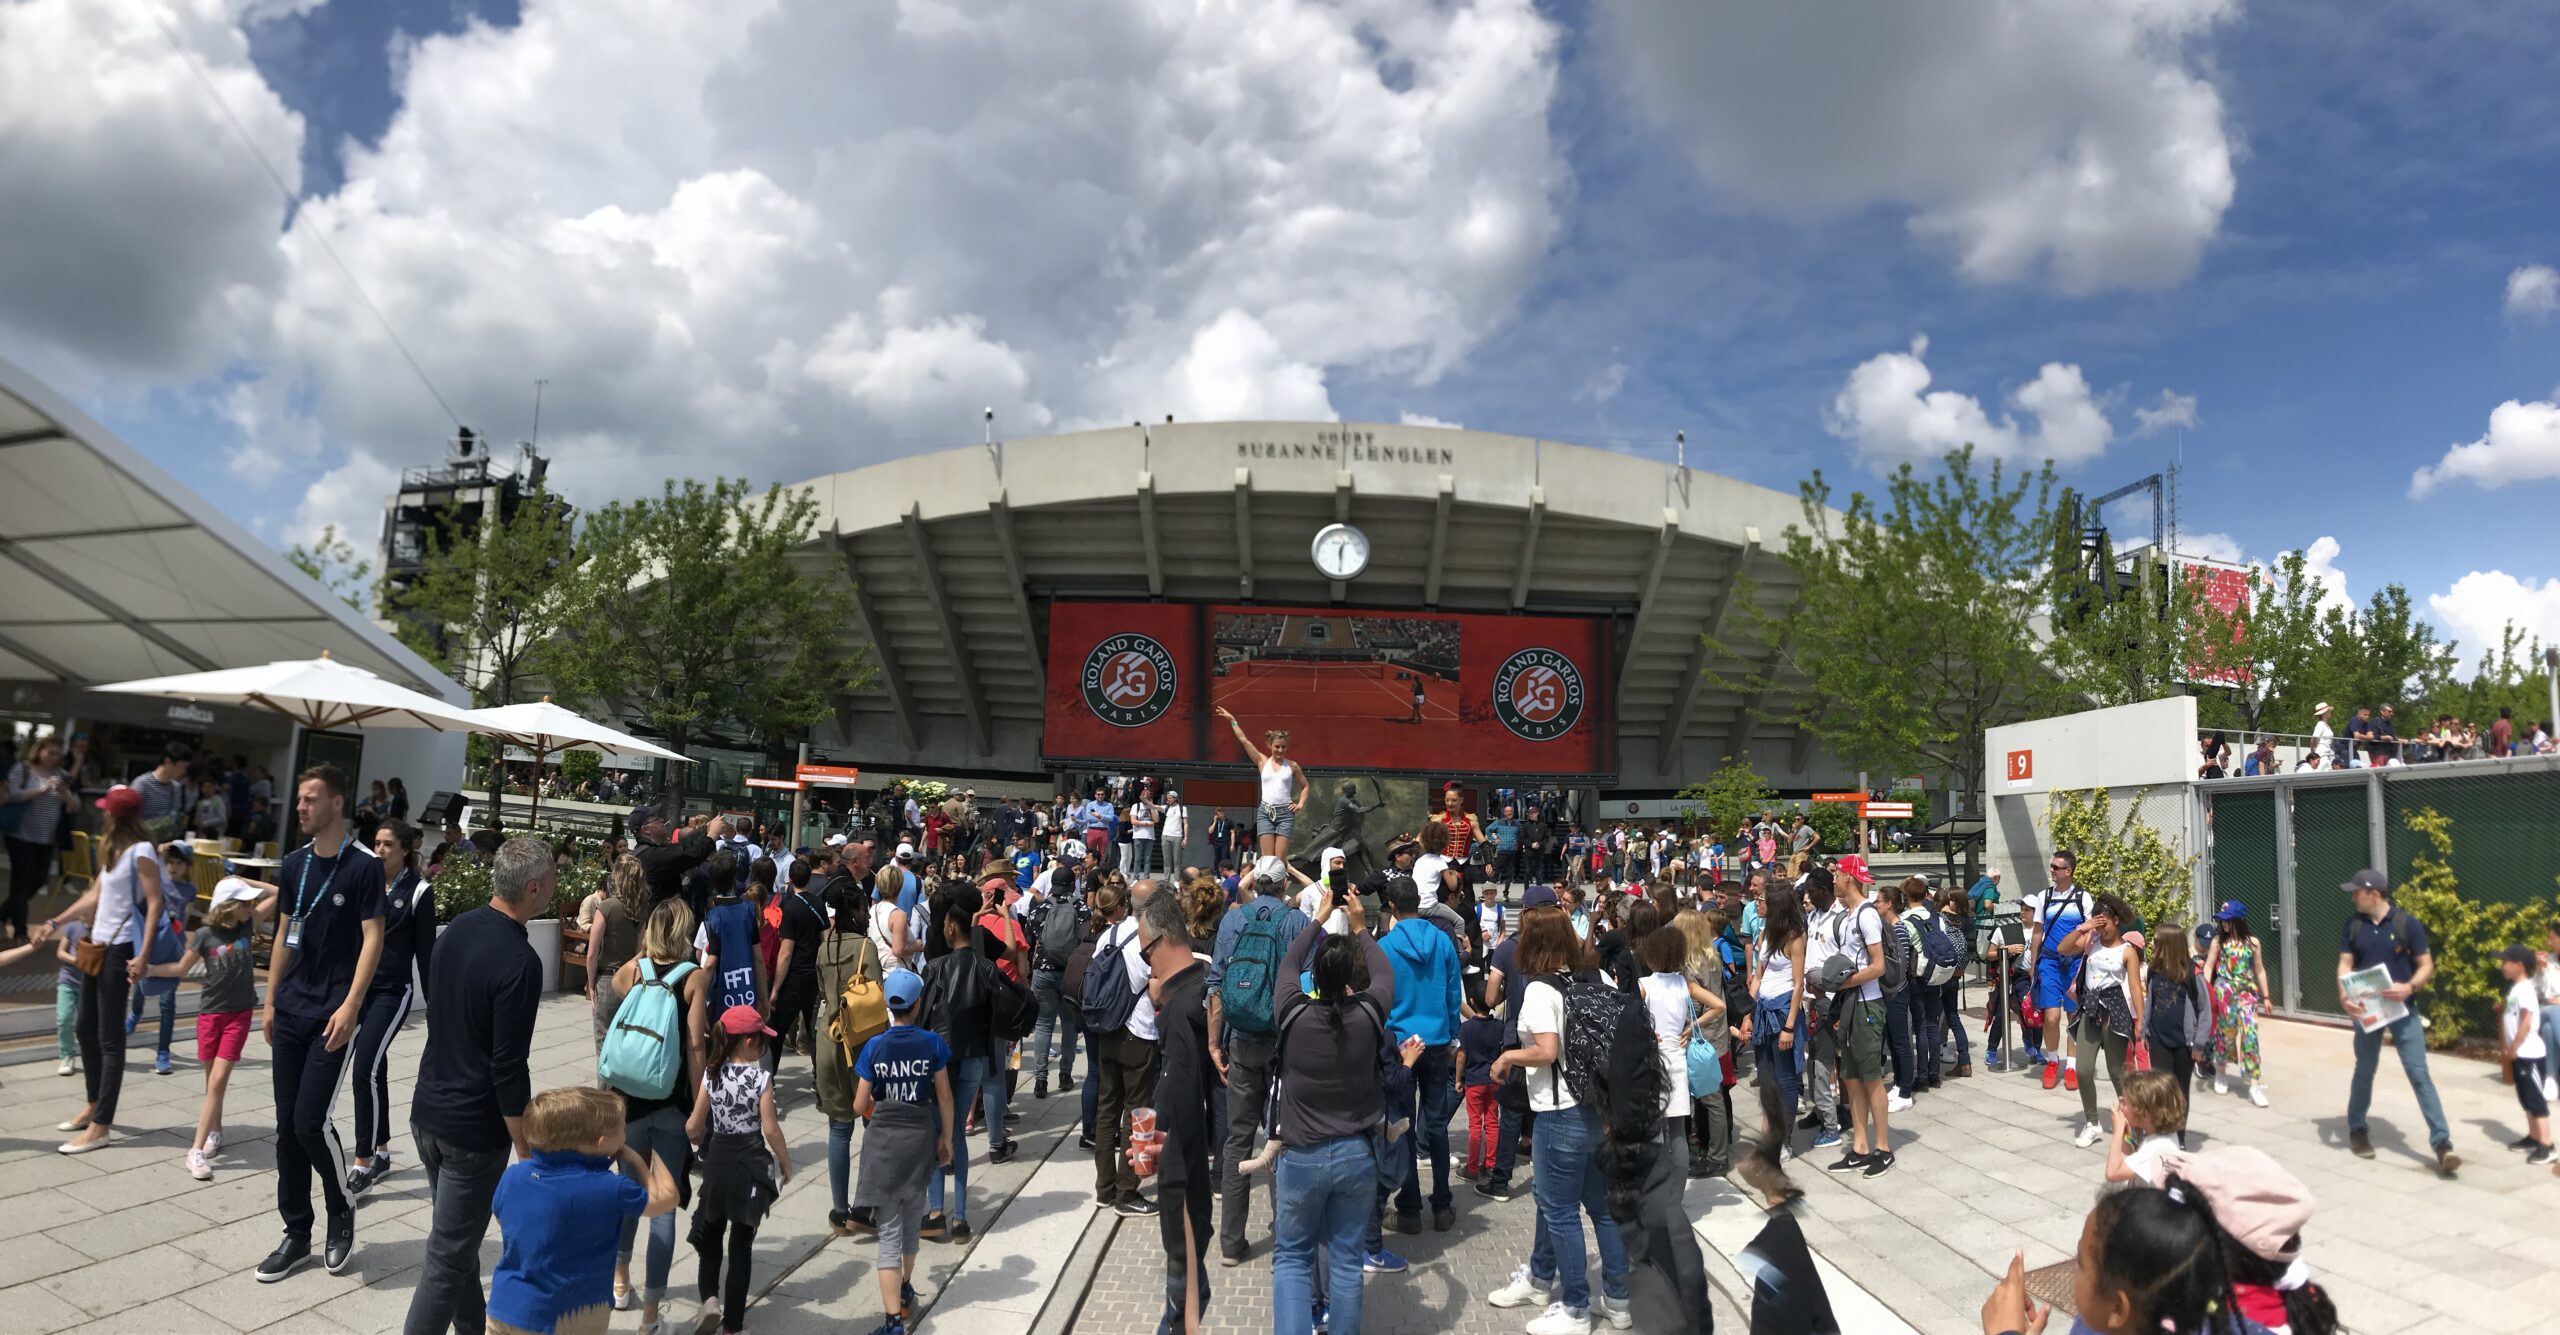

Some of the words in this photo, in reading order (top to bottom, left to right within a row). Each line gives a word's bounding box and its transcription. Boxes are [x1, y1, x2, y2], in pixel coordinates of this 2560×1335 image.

[1317, 432, 1375, 446] COURT
[1237, 442, 1338, 461] SUZANNE
[1353, 446, 1454, 465] LENGLEN
[1086, 638, 1128, 689] ROLAND
[1133, 639, 1173, 691] GARROS
[1497, 652, 1538, 703] ROLAND
[1541, 653, 1580, 705] GARROS
[1099, 702, 1158, 721] PARIS
[1510, 716, 1567, 735] PARIS
[2017, 754, 2027, 776] 9
[723, 967, 752, 990] FFT
[873, 1059, 930, 1079] FRANCE
[885, 1081, 919, 1102] MAX
